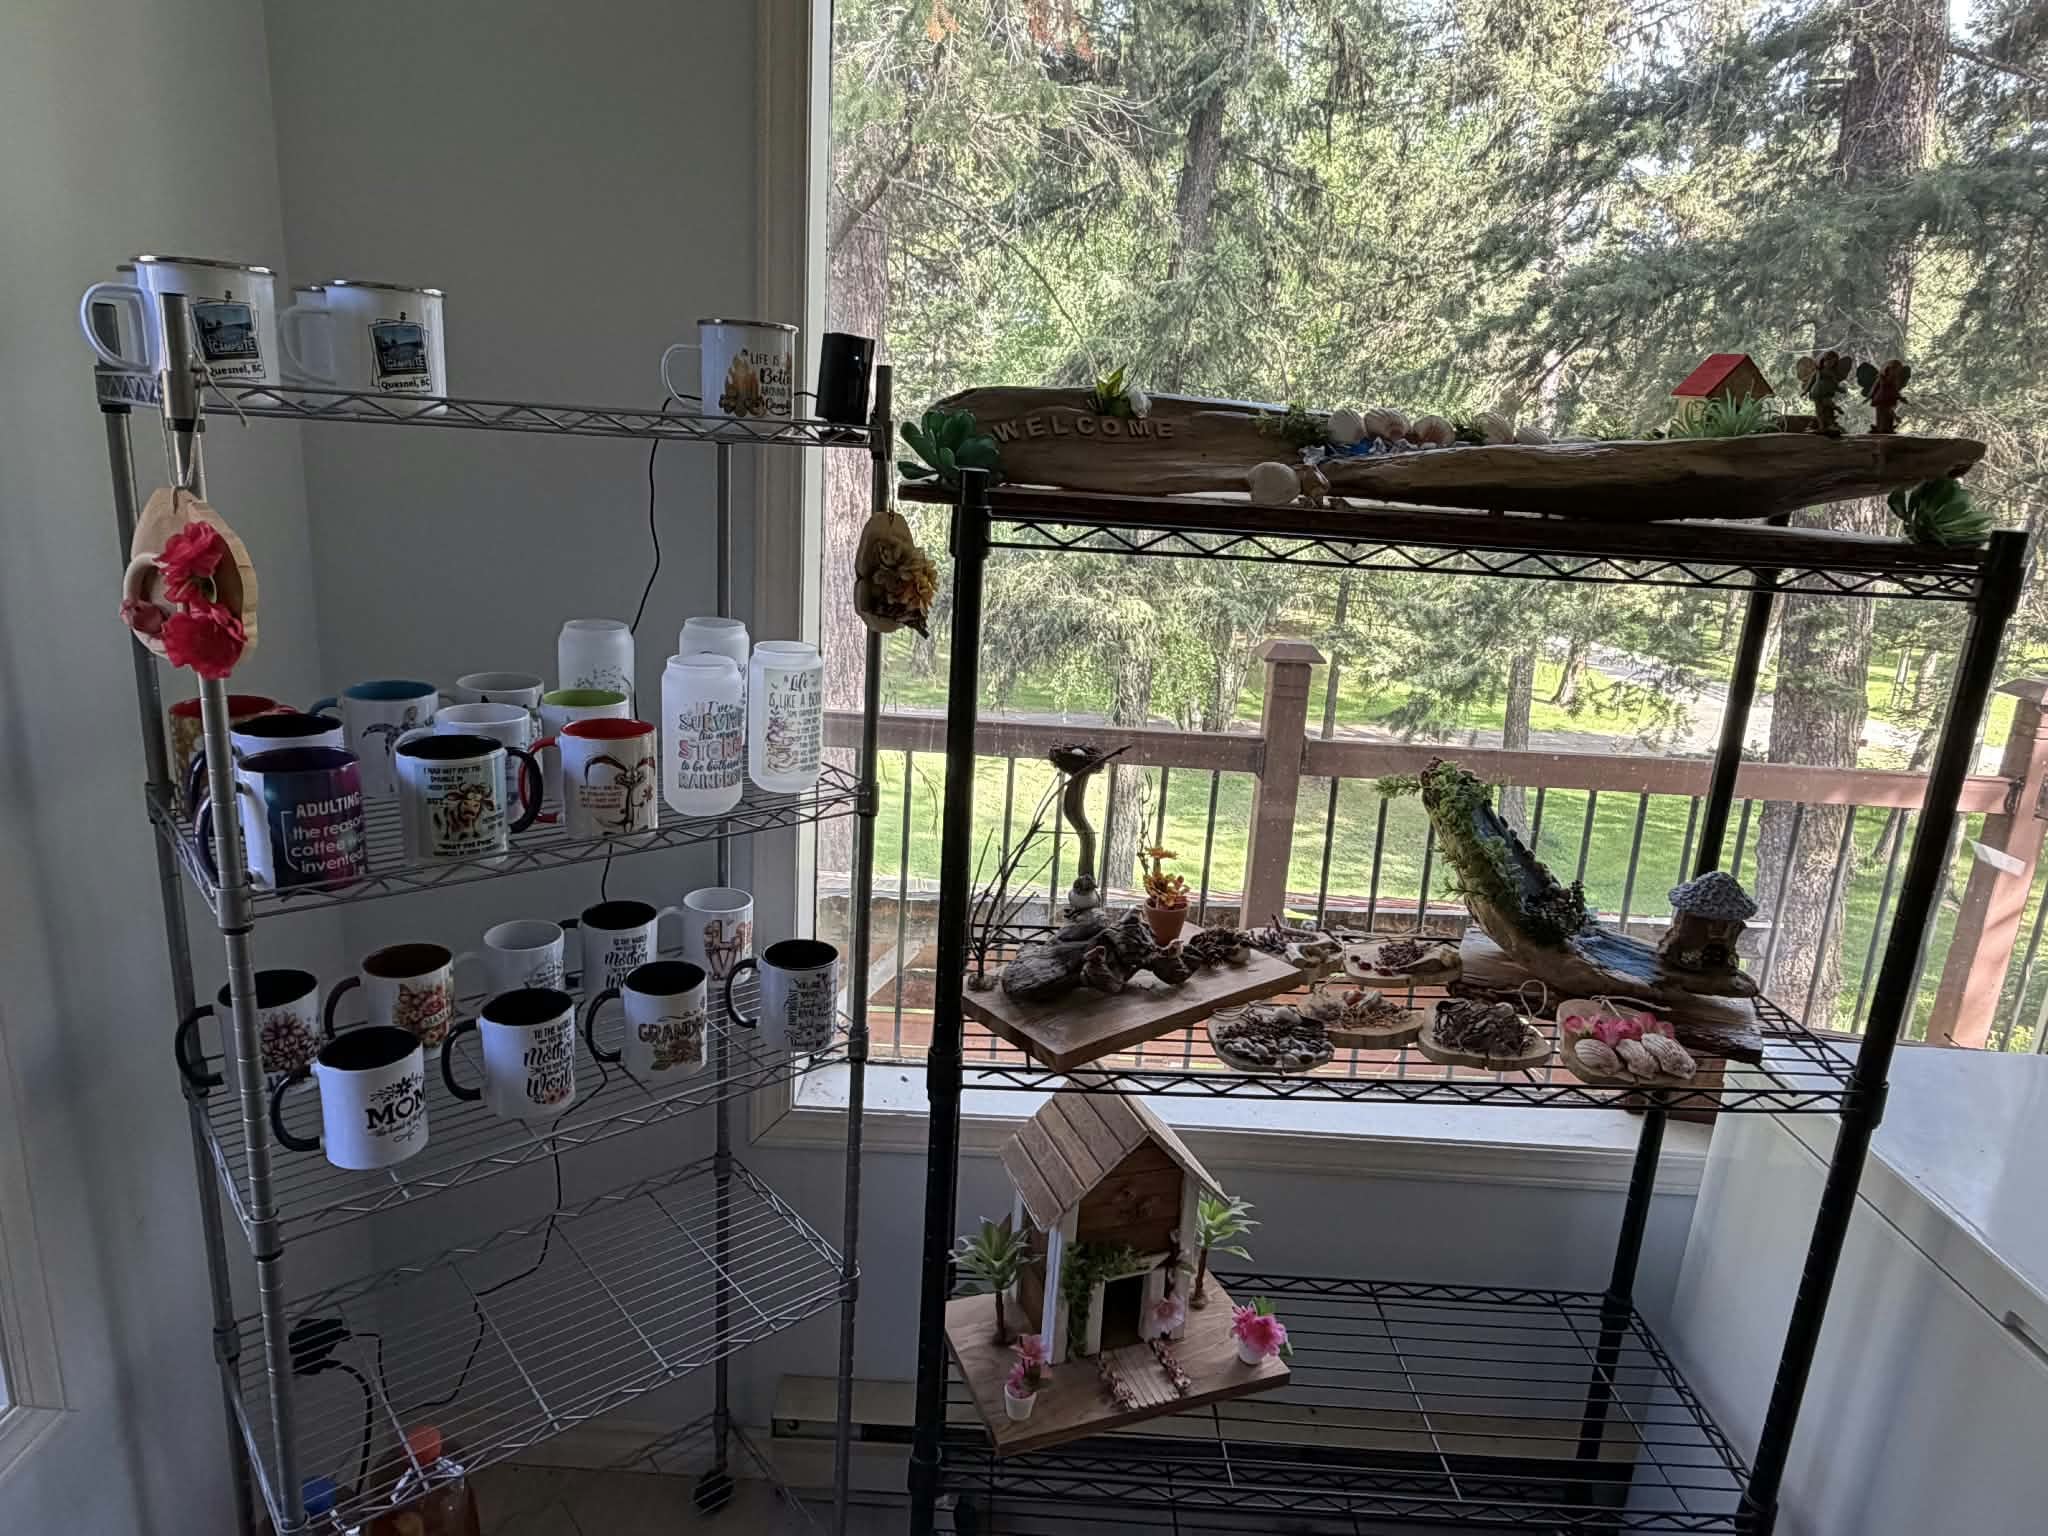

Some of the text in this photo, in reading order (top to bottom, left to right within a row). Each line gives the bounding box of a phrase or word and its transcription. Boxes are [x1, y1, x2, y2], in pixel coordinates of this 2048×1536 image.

[750, 352, 769, 366] LIFE
[992, 415, 1176, 443] WELCOME
[291, 826, 320, 841] the
